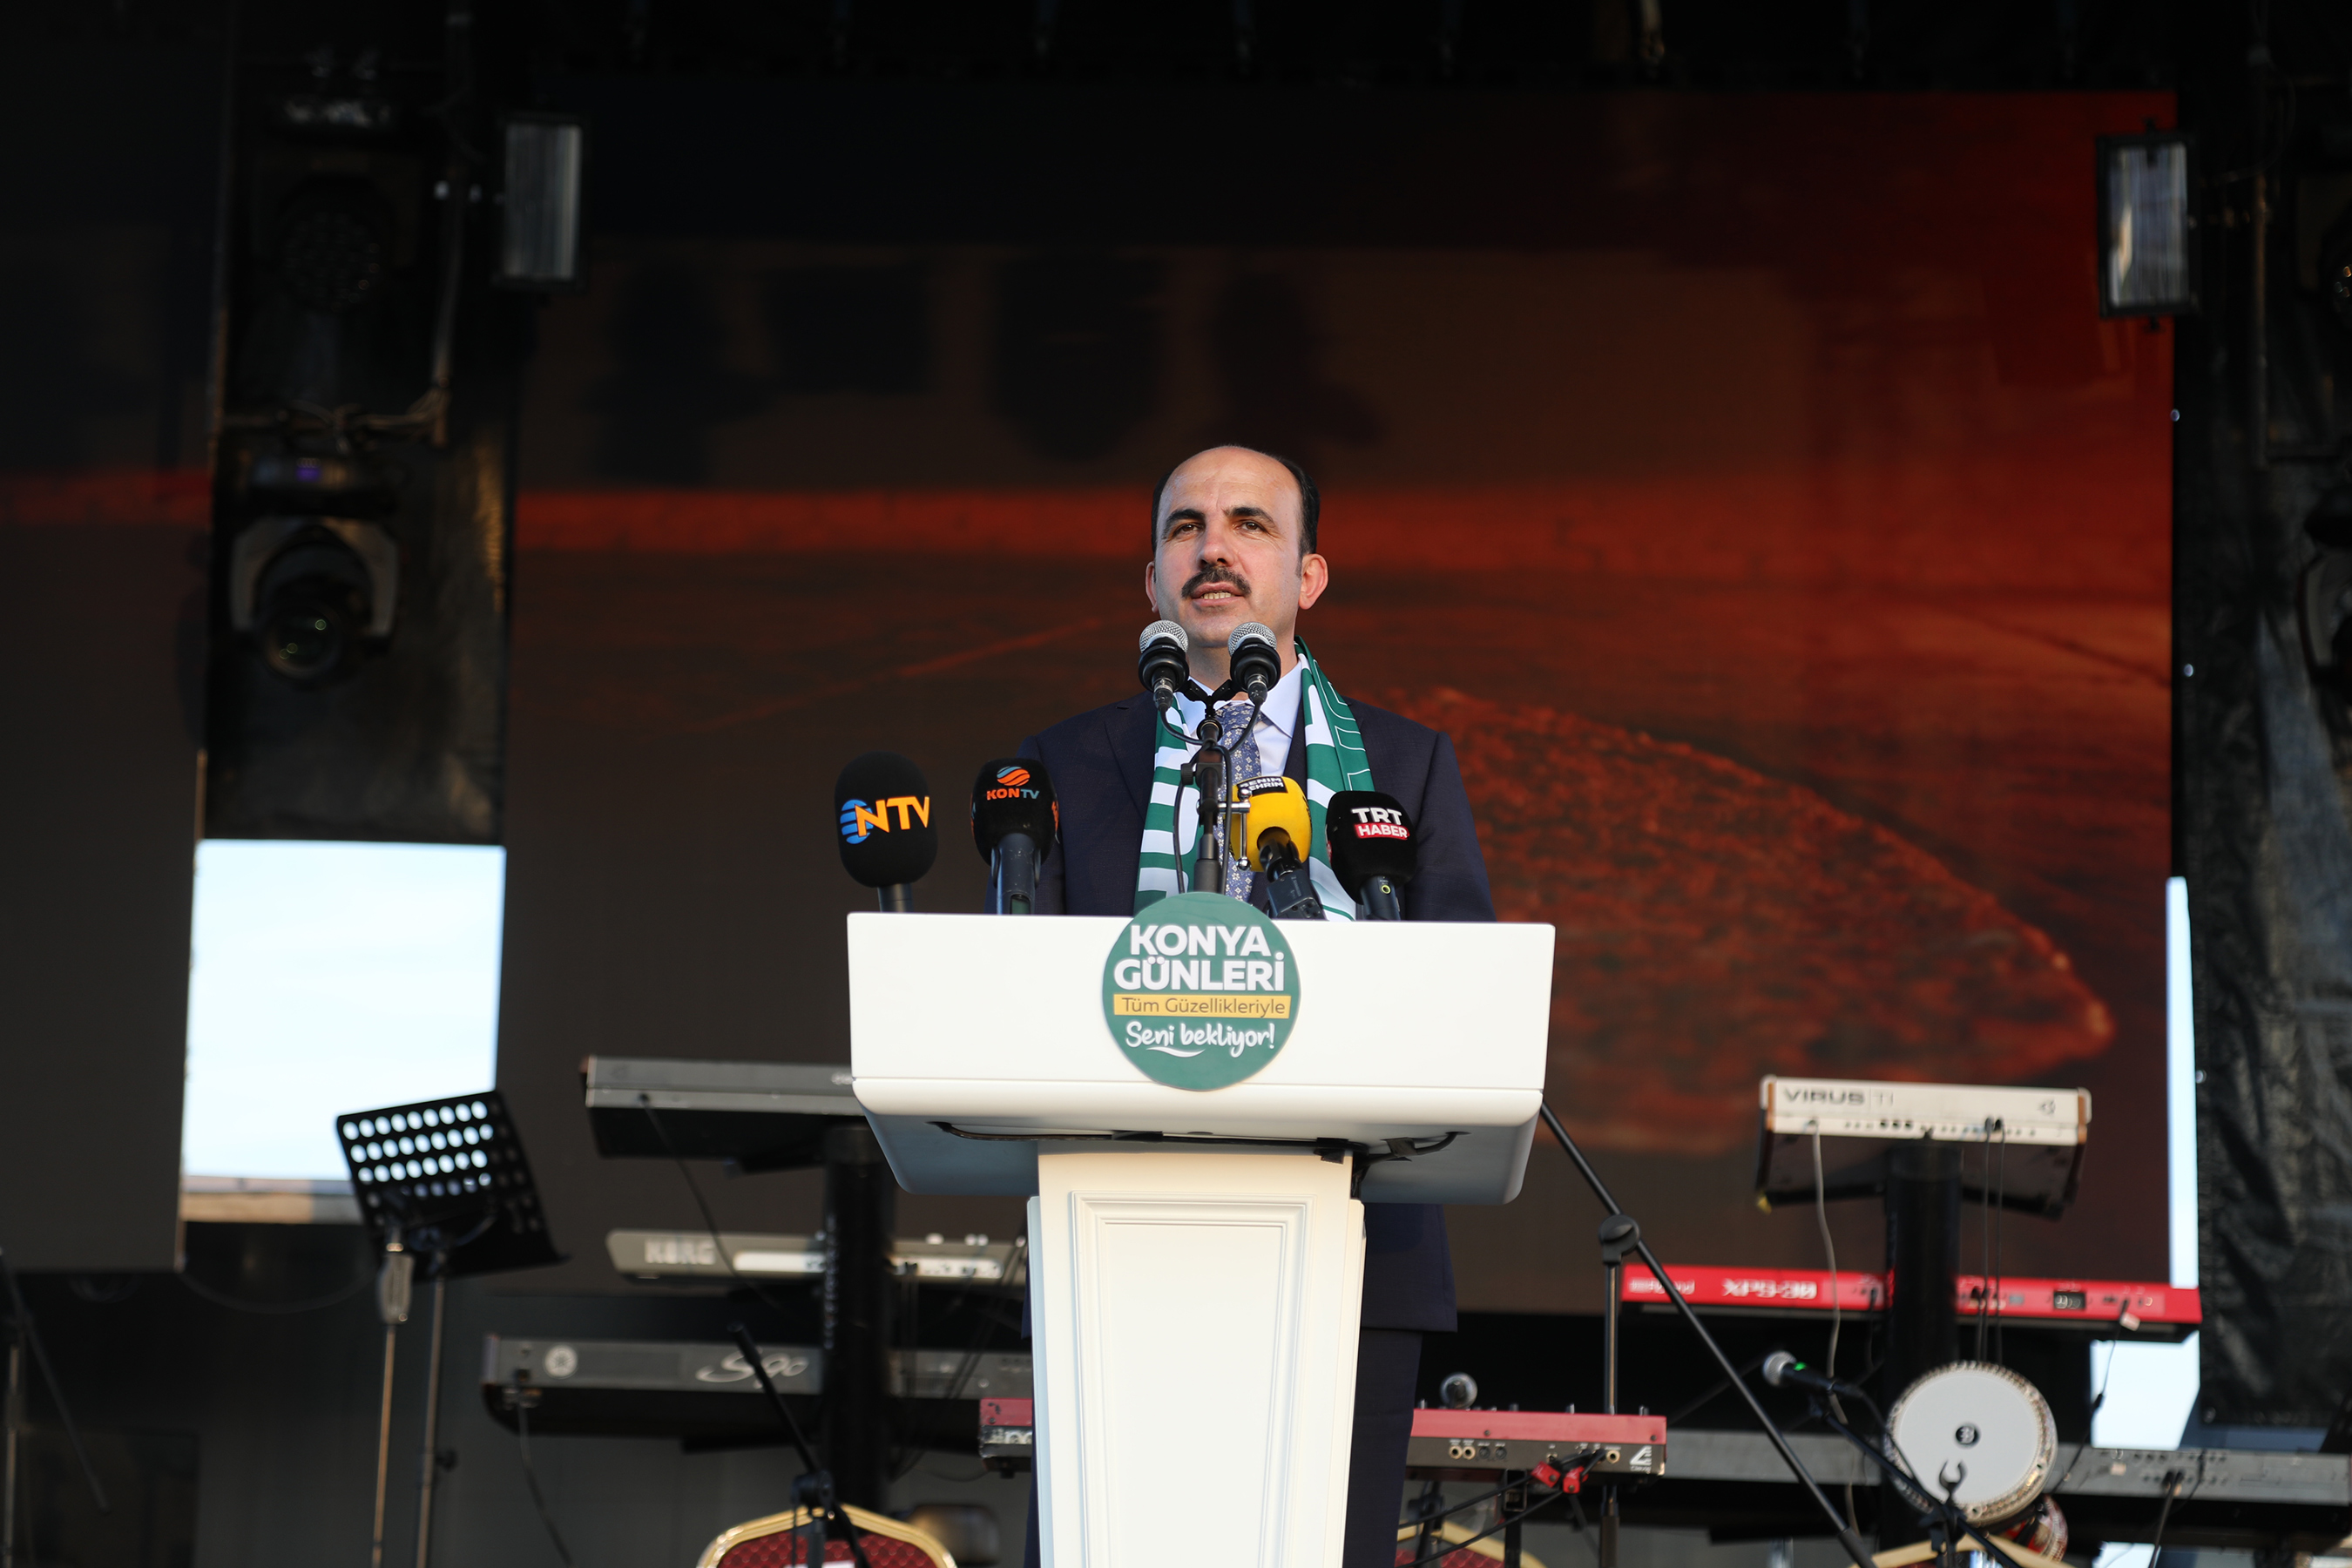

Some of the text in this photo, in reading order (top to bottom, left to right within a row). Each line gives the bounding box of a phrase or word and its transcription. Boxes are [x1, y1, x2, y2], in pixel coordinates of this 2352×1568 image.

[854, 796, 929, 837] NTV
[1352, 808, 1402, 826] TRT
[1358, 824, 1408, 838] HABER
[1131, 925, 1272, 956] KONYA
[1113, 952, 1284, 991] GÜNLERİ
[1122, 997, 1285, 1018] Tüm Güzellikleriyle
[1125, 1021, 1275, 1058] Seni bekliyor!
[1785, 1089, 1865, 1105] VIRUS
[645, 1240, 716, 1265] KORG
